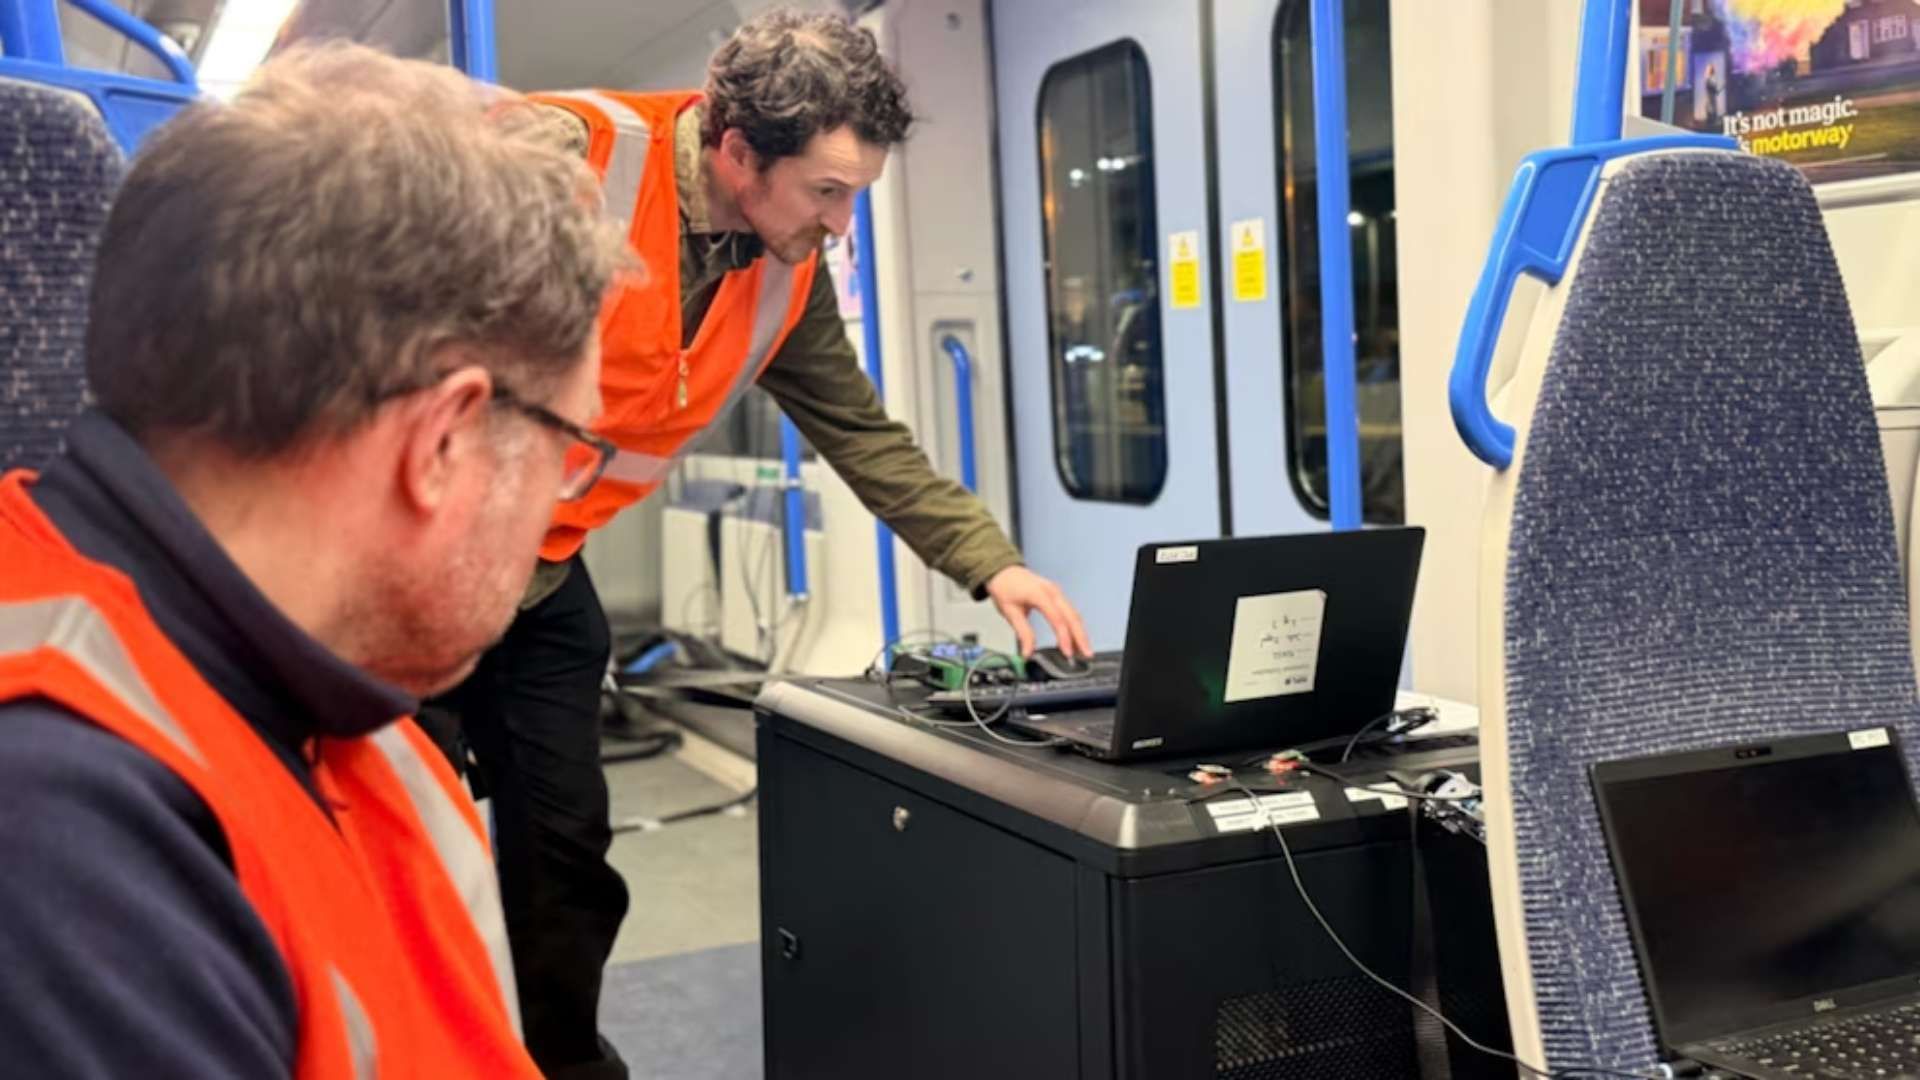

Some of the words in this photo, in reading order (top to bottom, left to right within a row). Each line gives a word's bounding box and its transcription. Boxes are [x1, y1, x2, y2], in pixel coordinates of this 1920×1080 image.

[1723, 111, 1750, 135] It's
[1752, 108, 1785, 131] not
[1789, 95, 1858, 126] magic.
[1752, 124, 1854, 155] motorway
